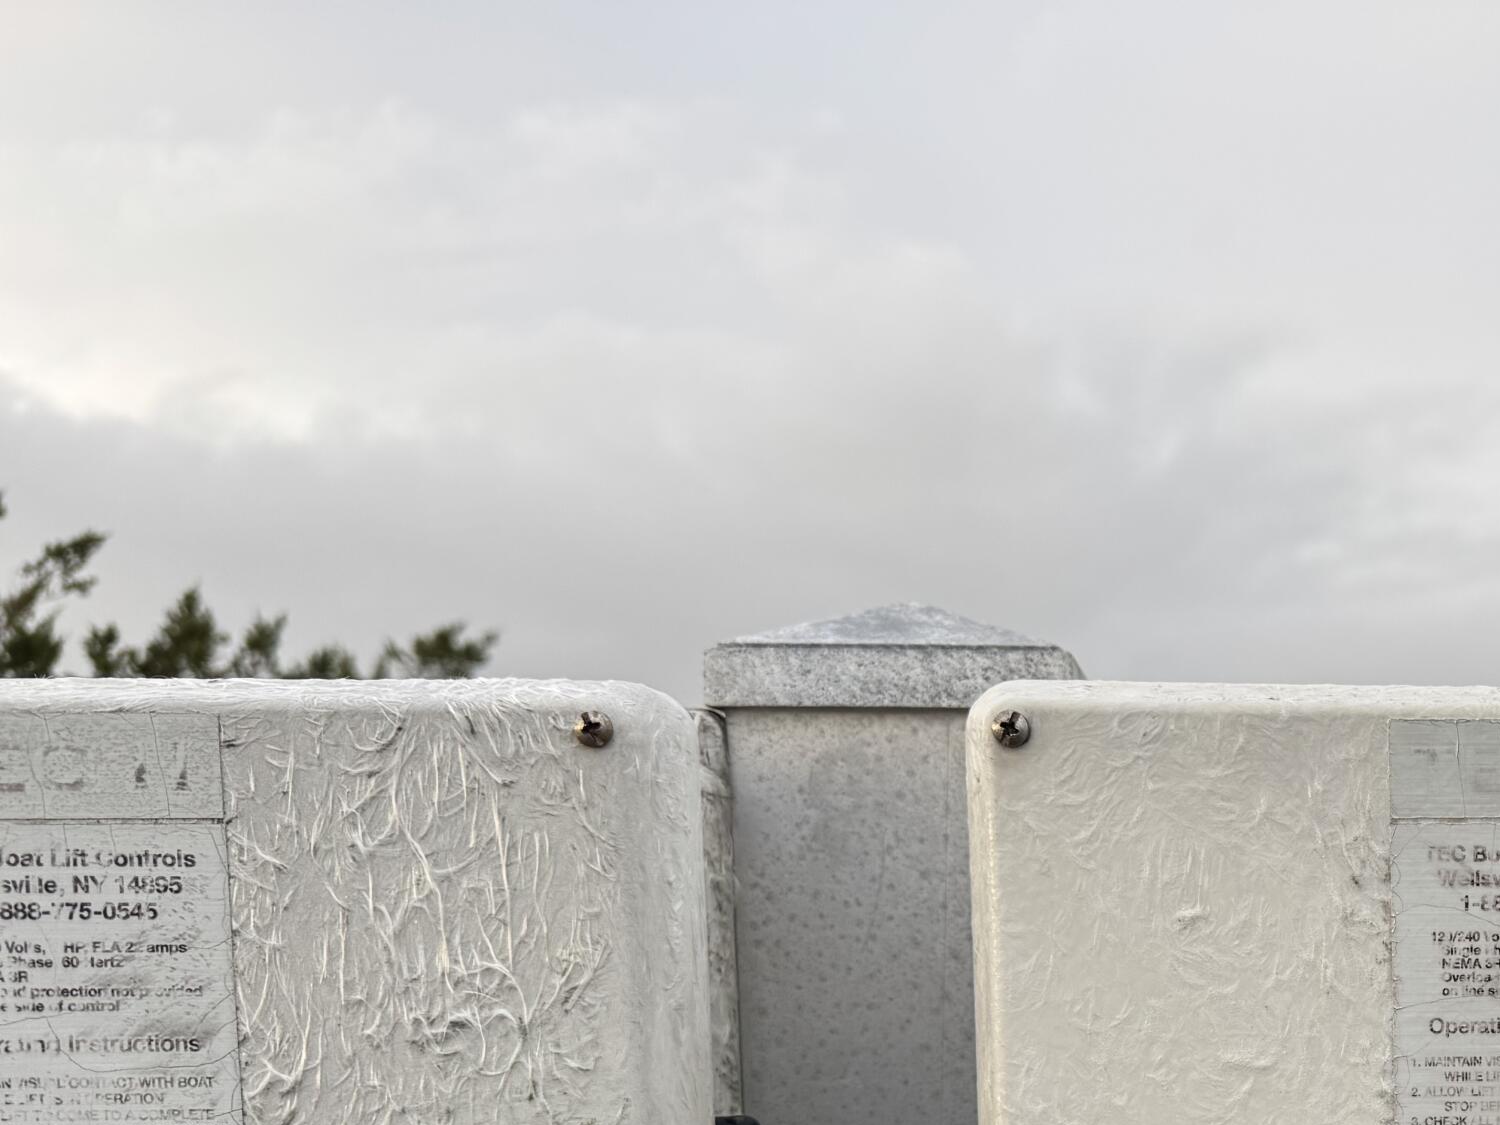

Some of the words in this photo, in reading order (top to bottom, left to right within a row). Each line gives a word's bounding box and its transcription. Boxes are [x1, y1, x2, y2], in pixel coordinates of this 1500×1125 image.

[0, 850, 44, 867] oat
[51, 848, 88, 867] Lift
[94, 849, 196, 867] Controls
[1, 876, 65, 897] svile,
[72, 875, 107, 894] NY
[4, 941, 46, 955] Vols,
[146, 943, 188, 956] amps
[62, 956, 79, 968] 60
[68, 1034, 201, 1052] Instructions
[1425, 1056, 1482, 1067] MAINTAIN
[138, 1076, 174, 1088] WITH
[177, 1076, 214, 1088] BOAT
[1444, 1071, 1483, 1082] WHILE
[1411, 1087, 1421, 1097] 2.
[1444, 1101, 1477, 1112] STOP
